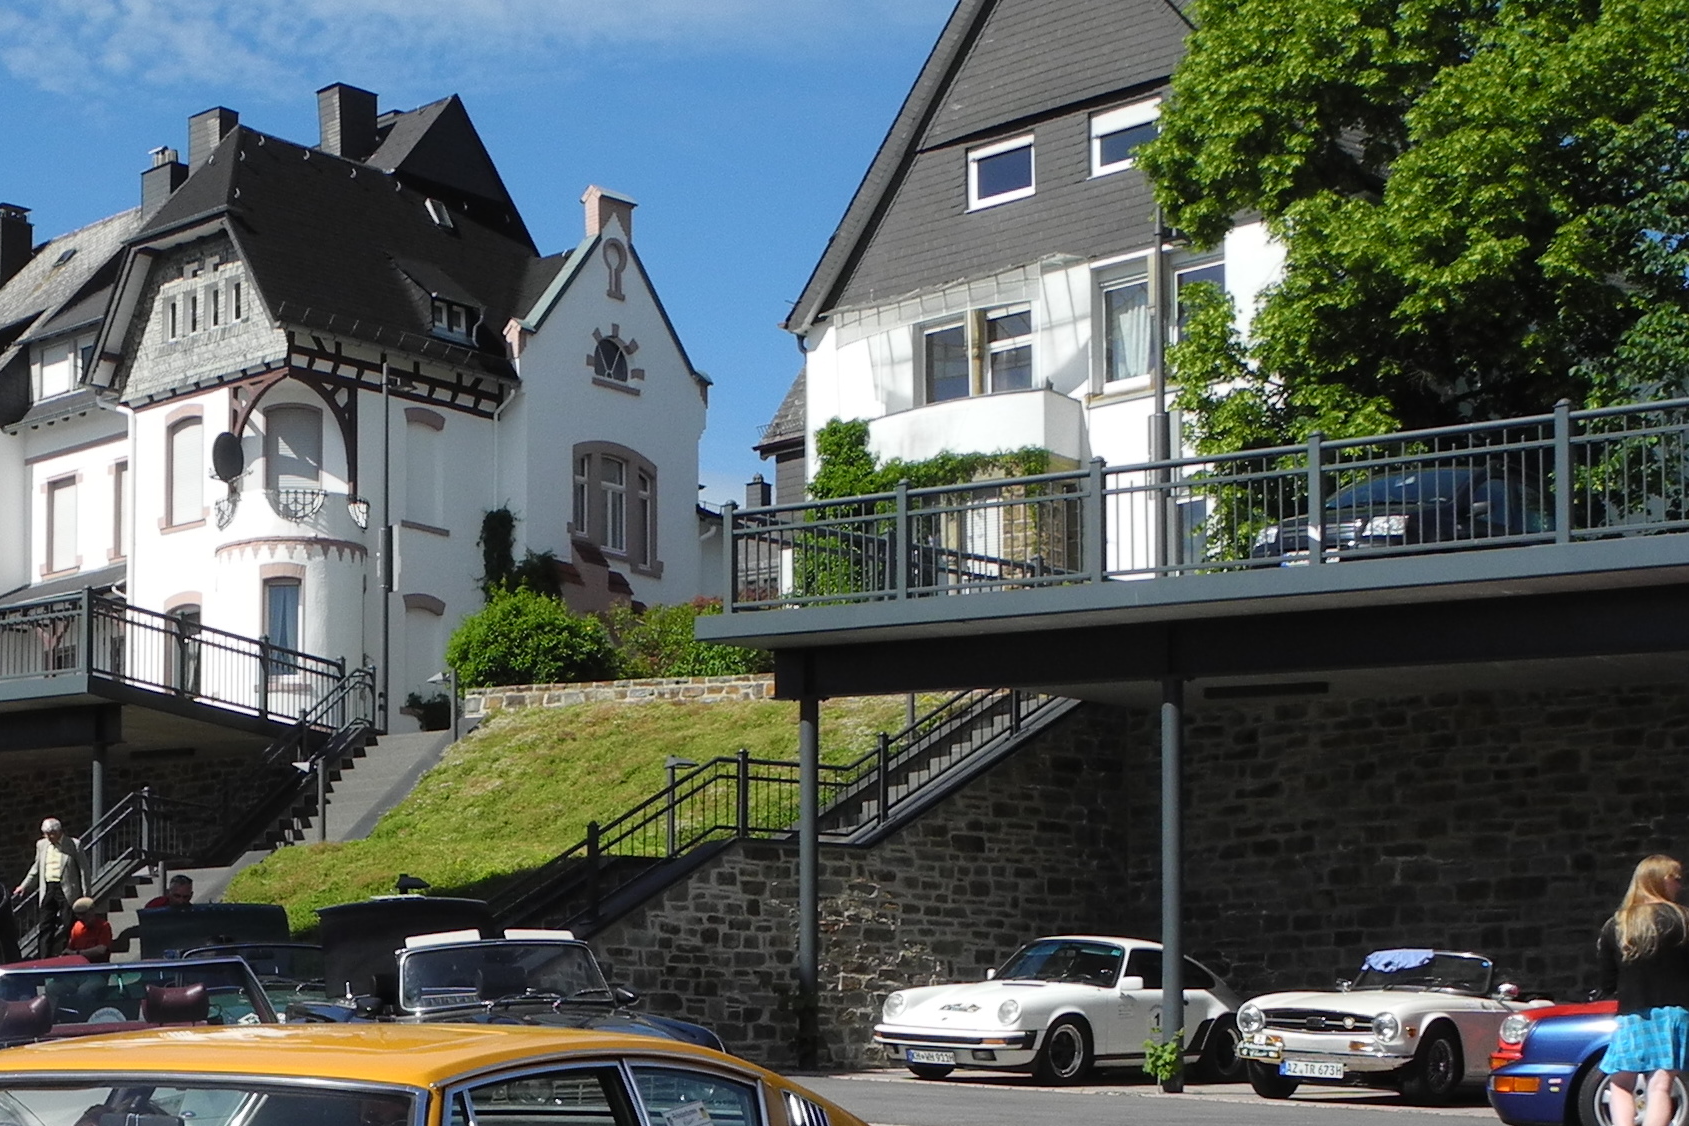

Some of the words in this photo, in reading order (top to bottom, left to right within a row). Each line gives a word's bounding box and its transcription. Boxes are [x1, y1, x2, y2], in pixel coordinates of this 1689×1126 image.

[1154, 1013, 1160, 1027] 1
[1286, 1061, 1298, 1074] AZ
[1304, 1062, 1316, 1075] TR
[1318, 1063, 1343, 1077] 673H
